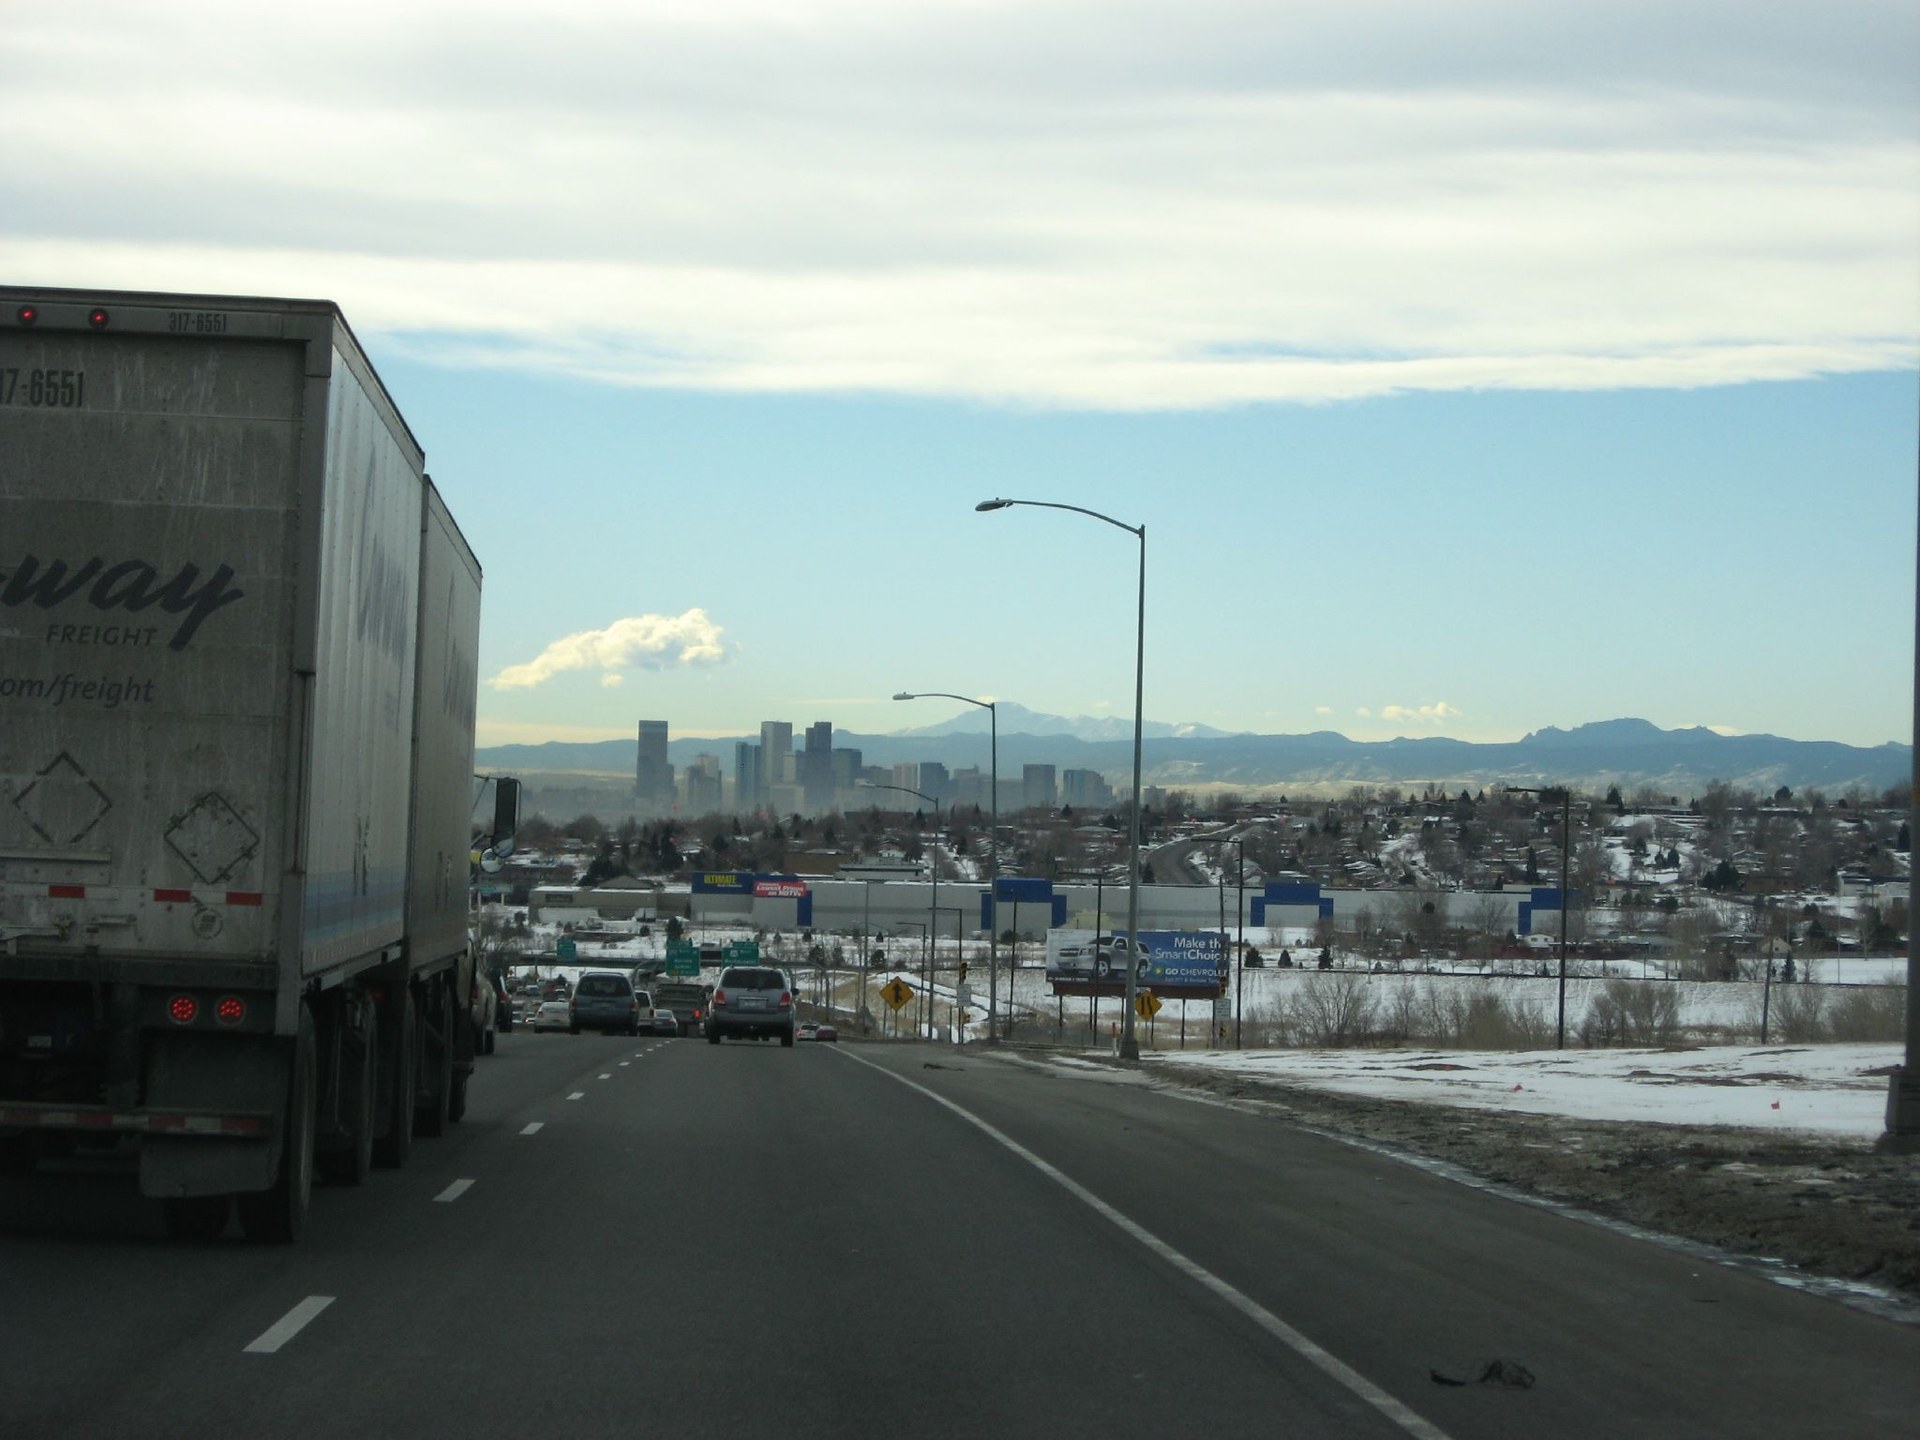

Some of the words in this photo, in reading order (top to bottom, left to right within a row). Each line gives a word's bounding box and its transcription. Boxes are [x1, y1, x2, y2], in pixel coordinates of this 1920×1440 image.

[168, 311, 227, 333] 317-6551
[46, 624, 158, 646] FREIGHT
[0, 672, 154, 708] om/freight
[704, 874, 737, 884] ULTIMATE
[1174, 937, 1206, 949] Make
[1209, 938, 1225, 950] th
[1165, 968, 1179, 976] GO
